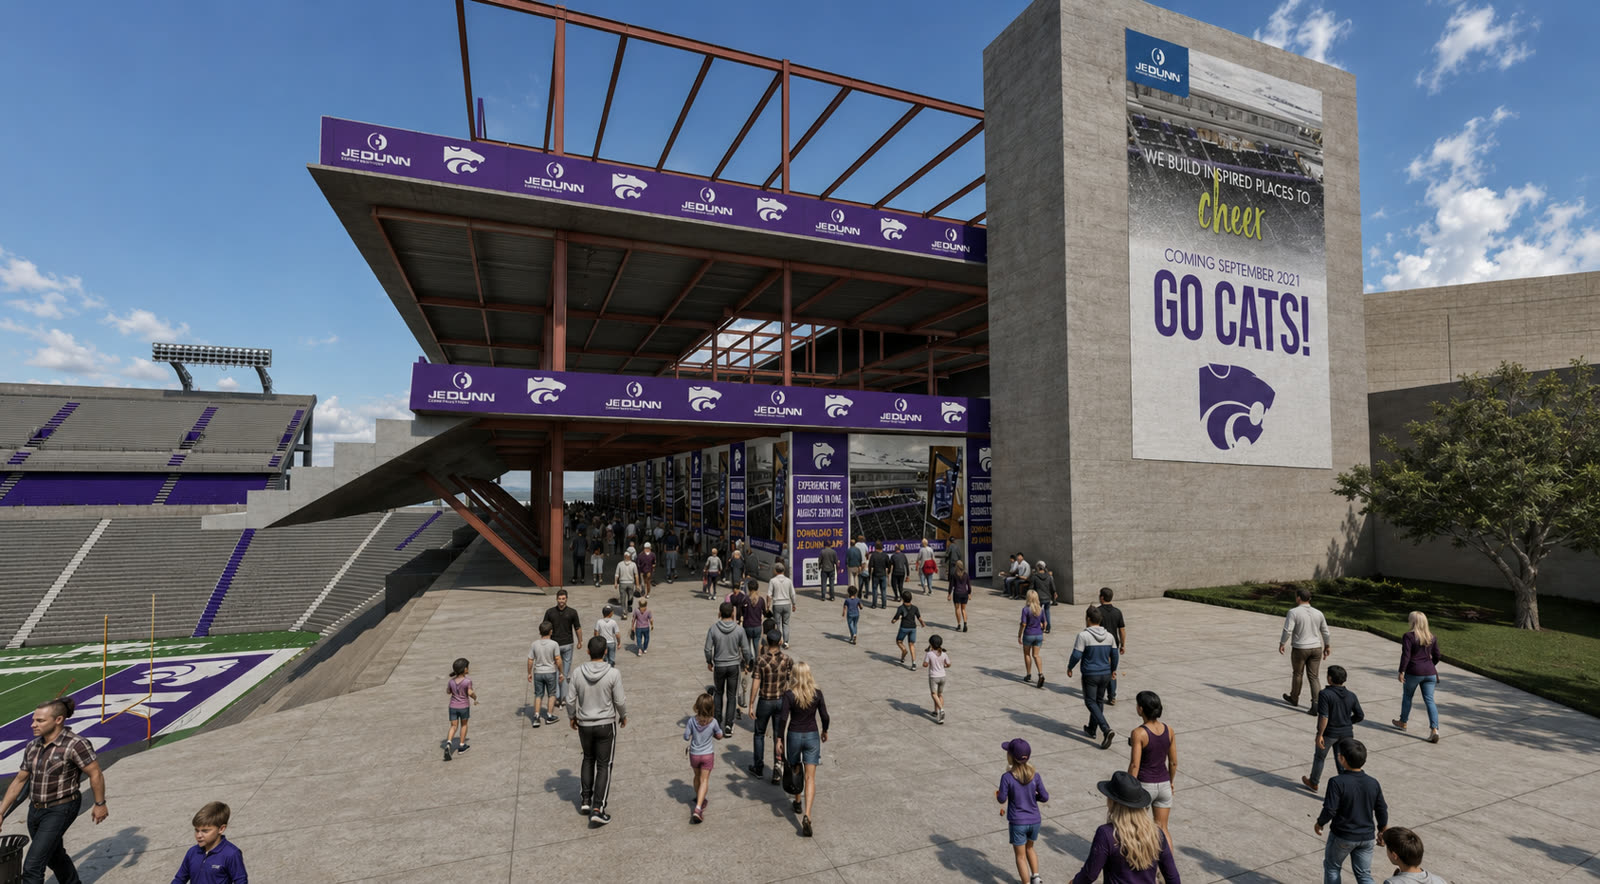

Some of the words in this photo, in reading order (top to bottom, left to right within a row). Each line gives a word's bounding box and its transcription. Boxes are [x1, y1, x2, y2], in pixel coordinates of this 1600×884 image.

[1144, 147, 1165, 165] WE
[1168, 157, 1201, 176] BUILD
[1204, 164, 1253, 190] INSPIRED
[1255, 181, 1295, 201] PLACES
[1296, 189, 1311, 205] TO
[1198, 168, 1266, 240] cheer
[1164, 248, 1215, 270] COMING
[1218, 258, 1274, 282] SEPTEMBER
[1277, 271, 1301, 288] 2021
[1154, 269, 1204, 341] GO
[1214, 280, 1311, 357] CATS!
